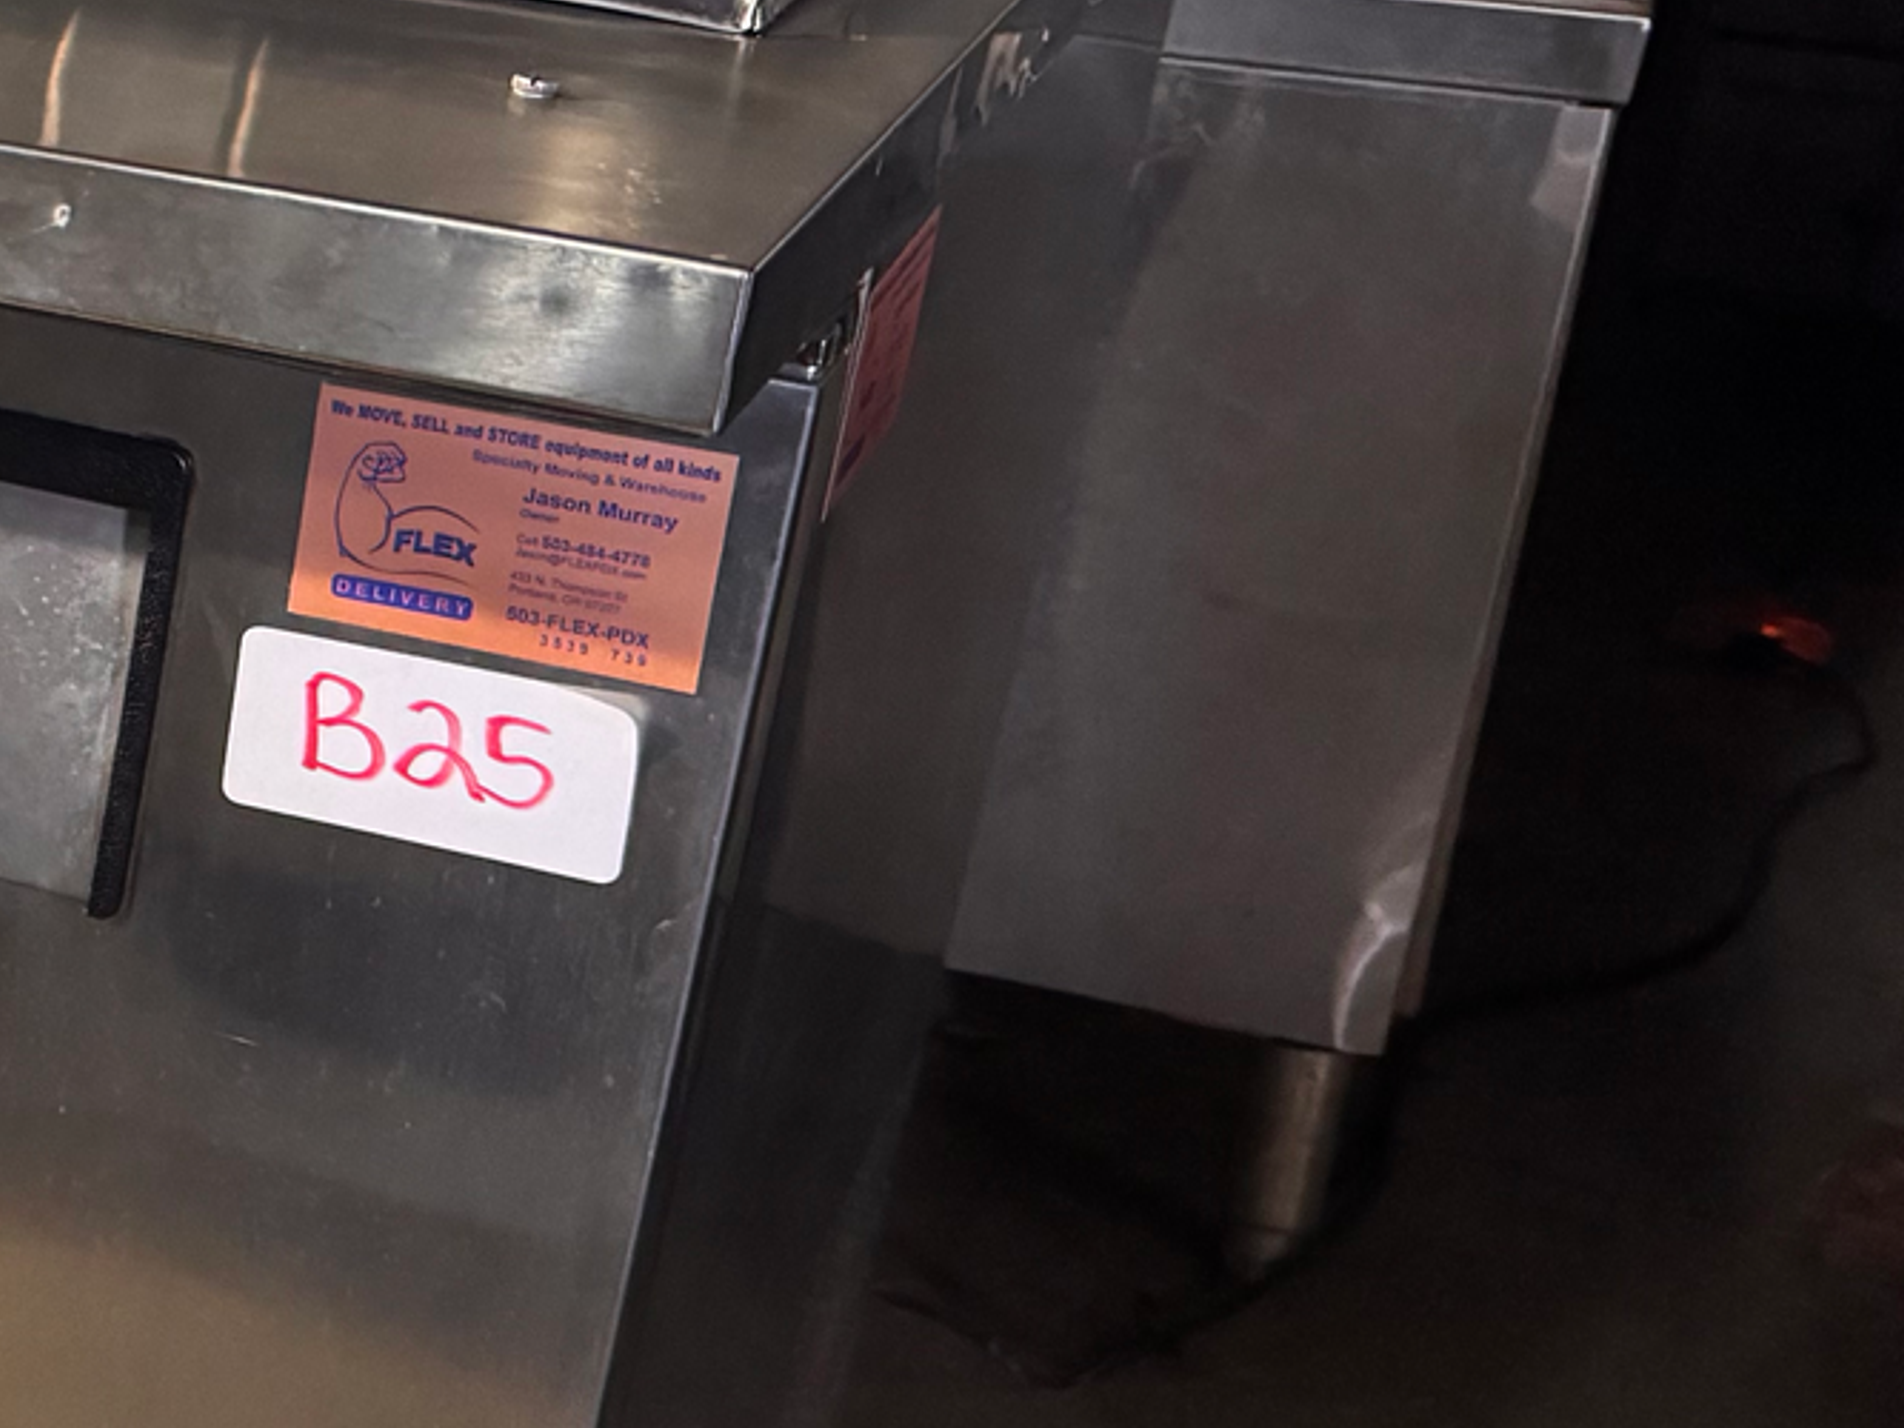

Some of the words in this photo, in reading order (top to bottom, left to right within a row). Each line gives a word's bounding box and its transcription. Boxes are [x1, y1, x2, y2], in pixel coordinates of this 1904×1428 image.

[357, 403, 407, 428] MOVE,
[411, 414, 449, 435] SELL
[454, 425, 483, 439] and
[488, 426, 540, 450] STORE
[545, 438, 630, 466] equipment
[632, 454, 650, 469] of
[653, 458, 674, 473] all
[678, 460, 722, 482] kinds
[544, 463, 600, 486] Moving
[604, 474, 616, 487] &
[619, 477, 708, 503] Warehouse
[523, 488, 592, 514] Jason
[597, 499, 679, 534] Murray
[392, 529, 478, 567] FLEX
[335, 577, 470, 618] DELIVERY
[505, 605, 650, 650] 503-FLEX-PDX
[302, 670, 555, 811] B25
